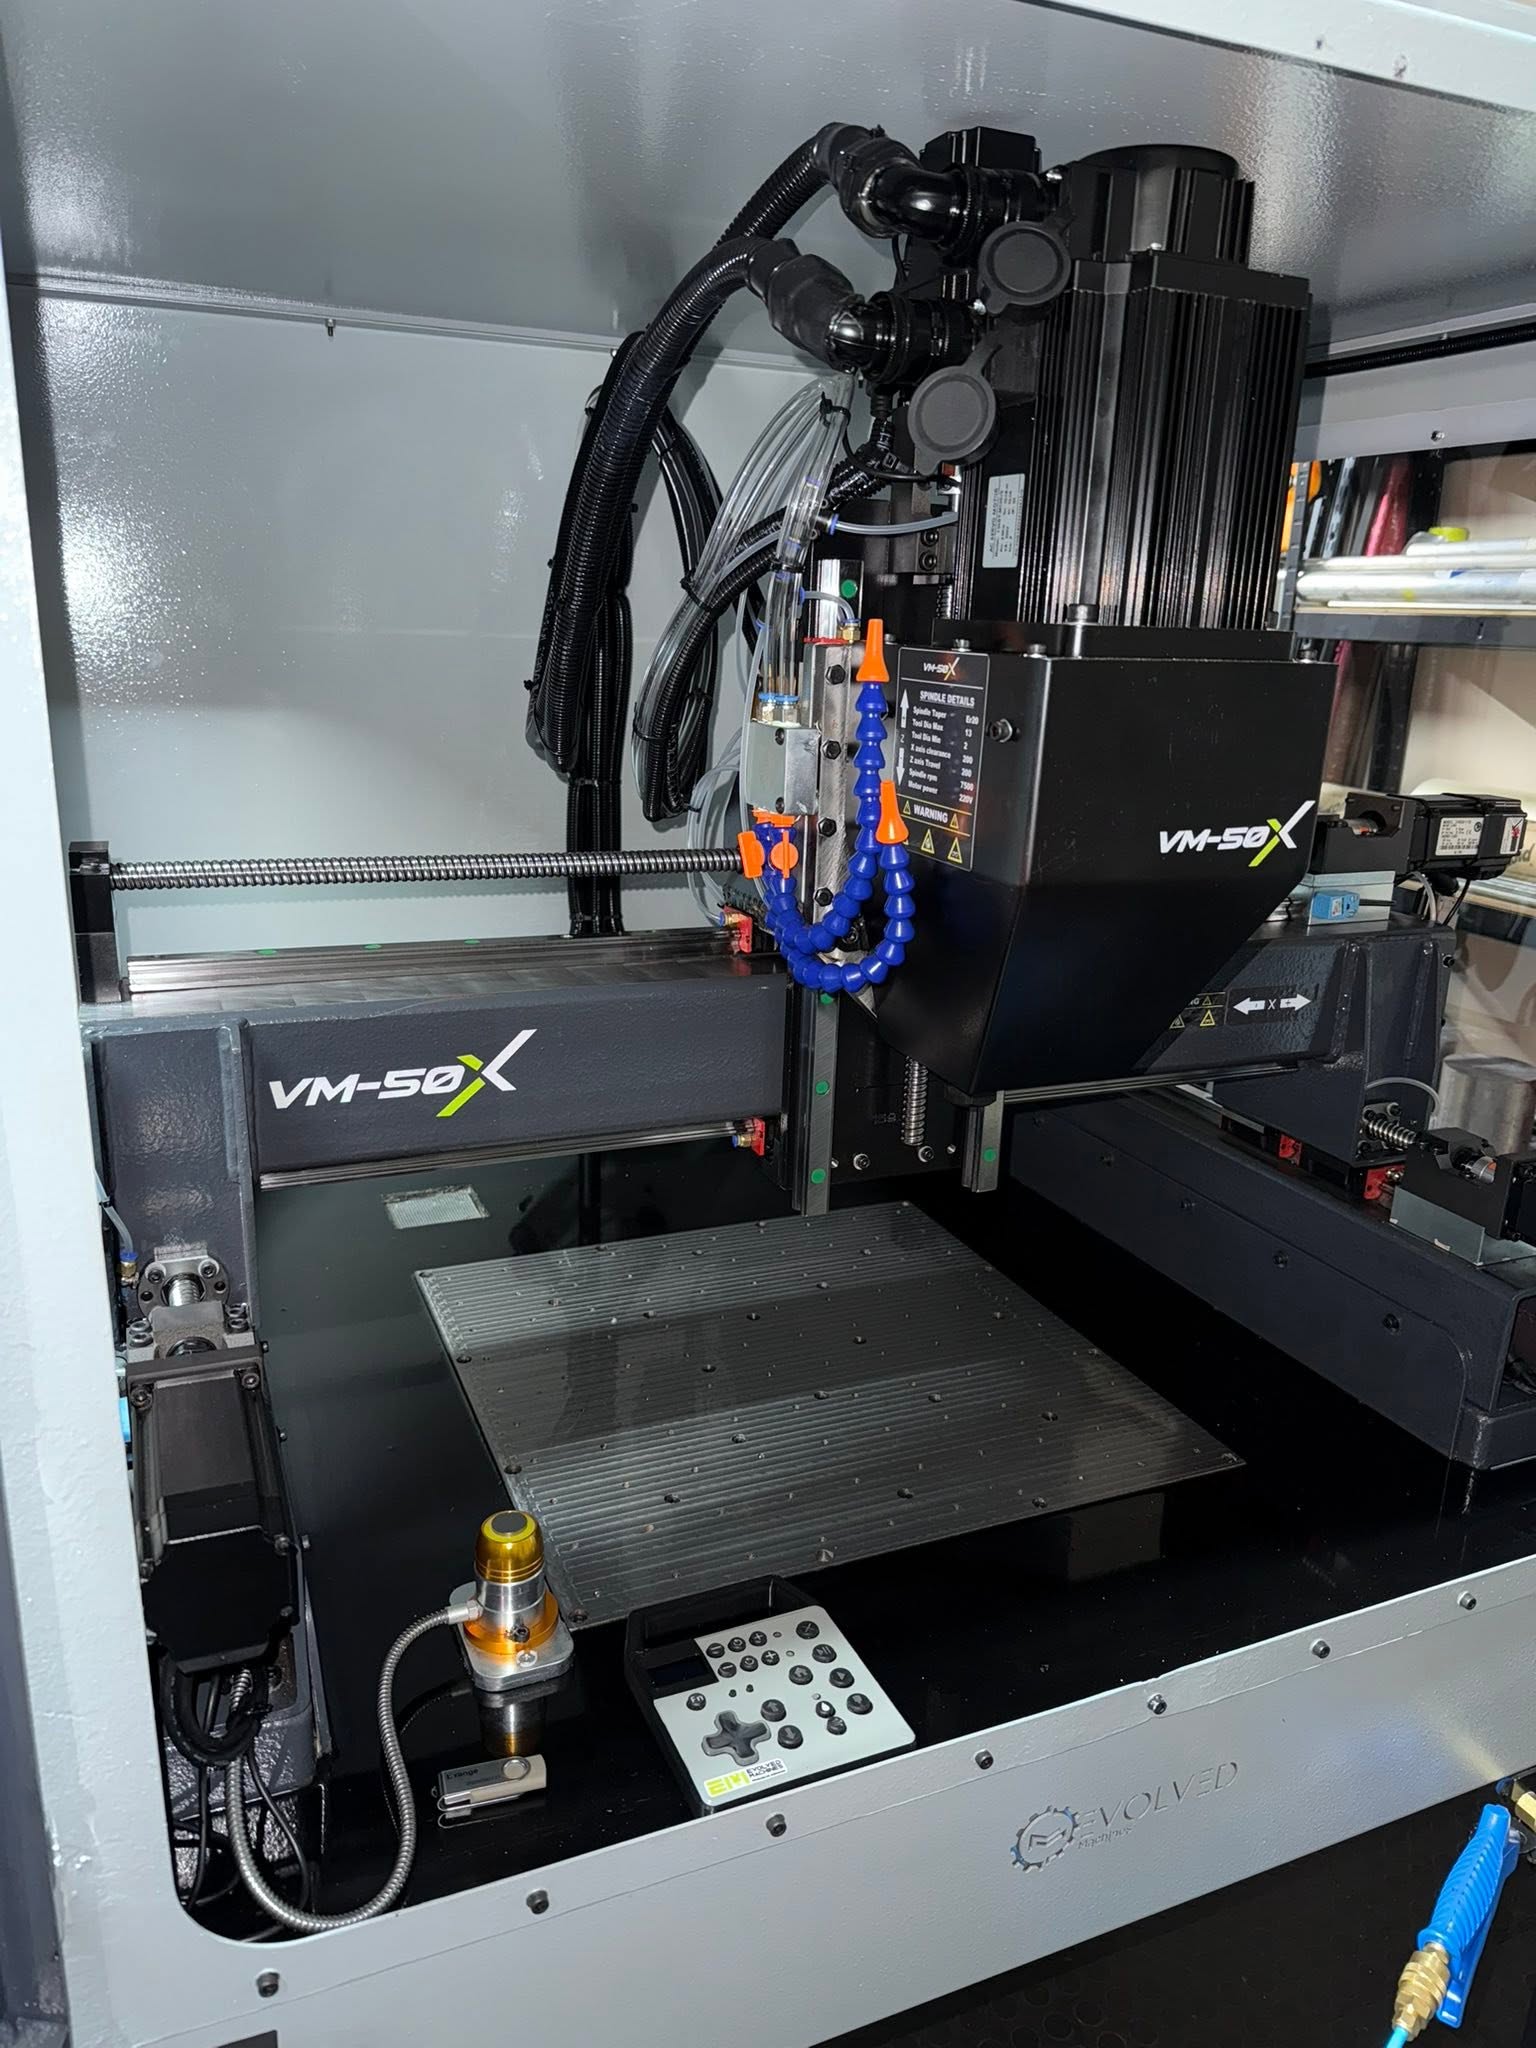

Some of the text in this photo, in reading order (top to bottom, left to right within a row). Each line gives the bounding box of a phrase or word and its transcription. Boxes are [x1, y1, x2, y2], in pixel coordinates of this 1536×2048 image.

[920, 690, 975, 707] SPINDLE DETAILS
[913, 706, 931, 717] Spindle
[932, 709, 947, 719] Taper
[912, 718, 922, 727] Tool
[923, 720, 932, 729] Dia
[912, 731, 922, 740] Tool
[922, 733, 931, 742] Dia
[915, 745, 926, 754] axis
[926, 747, 952, 759] clearance
[914, 758, 925, 766] axis
[925, 759, 941, 770] Travel
[909, 768, 926, 780] Spindle
[922, 785, 938, 795] power
[913, 804, 948, 824] WARNING
[1159, 800, 1316, 867] VM-50X
[1267, 999, 1276, 1010] X
[269, 1028, 538, 1118] VM-50X
[746, 1760, 781, 1774] EVOLVED
[1079, 1761, 1238, 1838] EVOLVED
